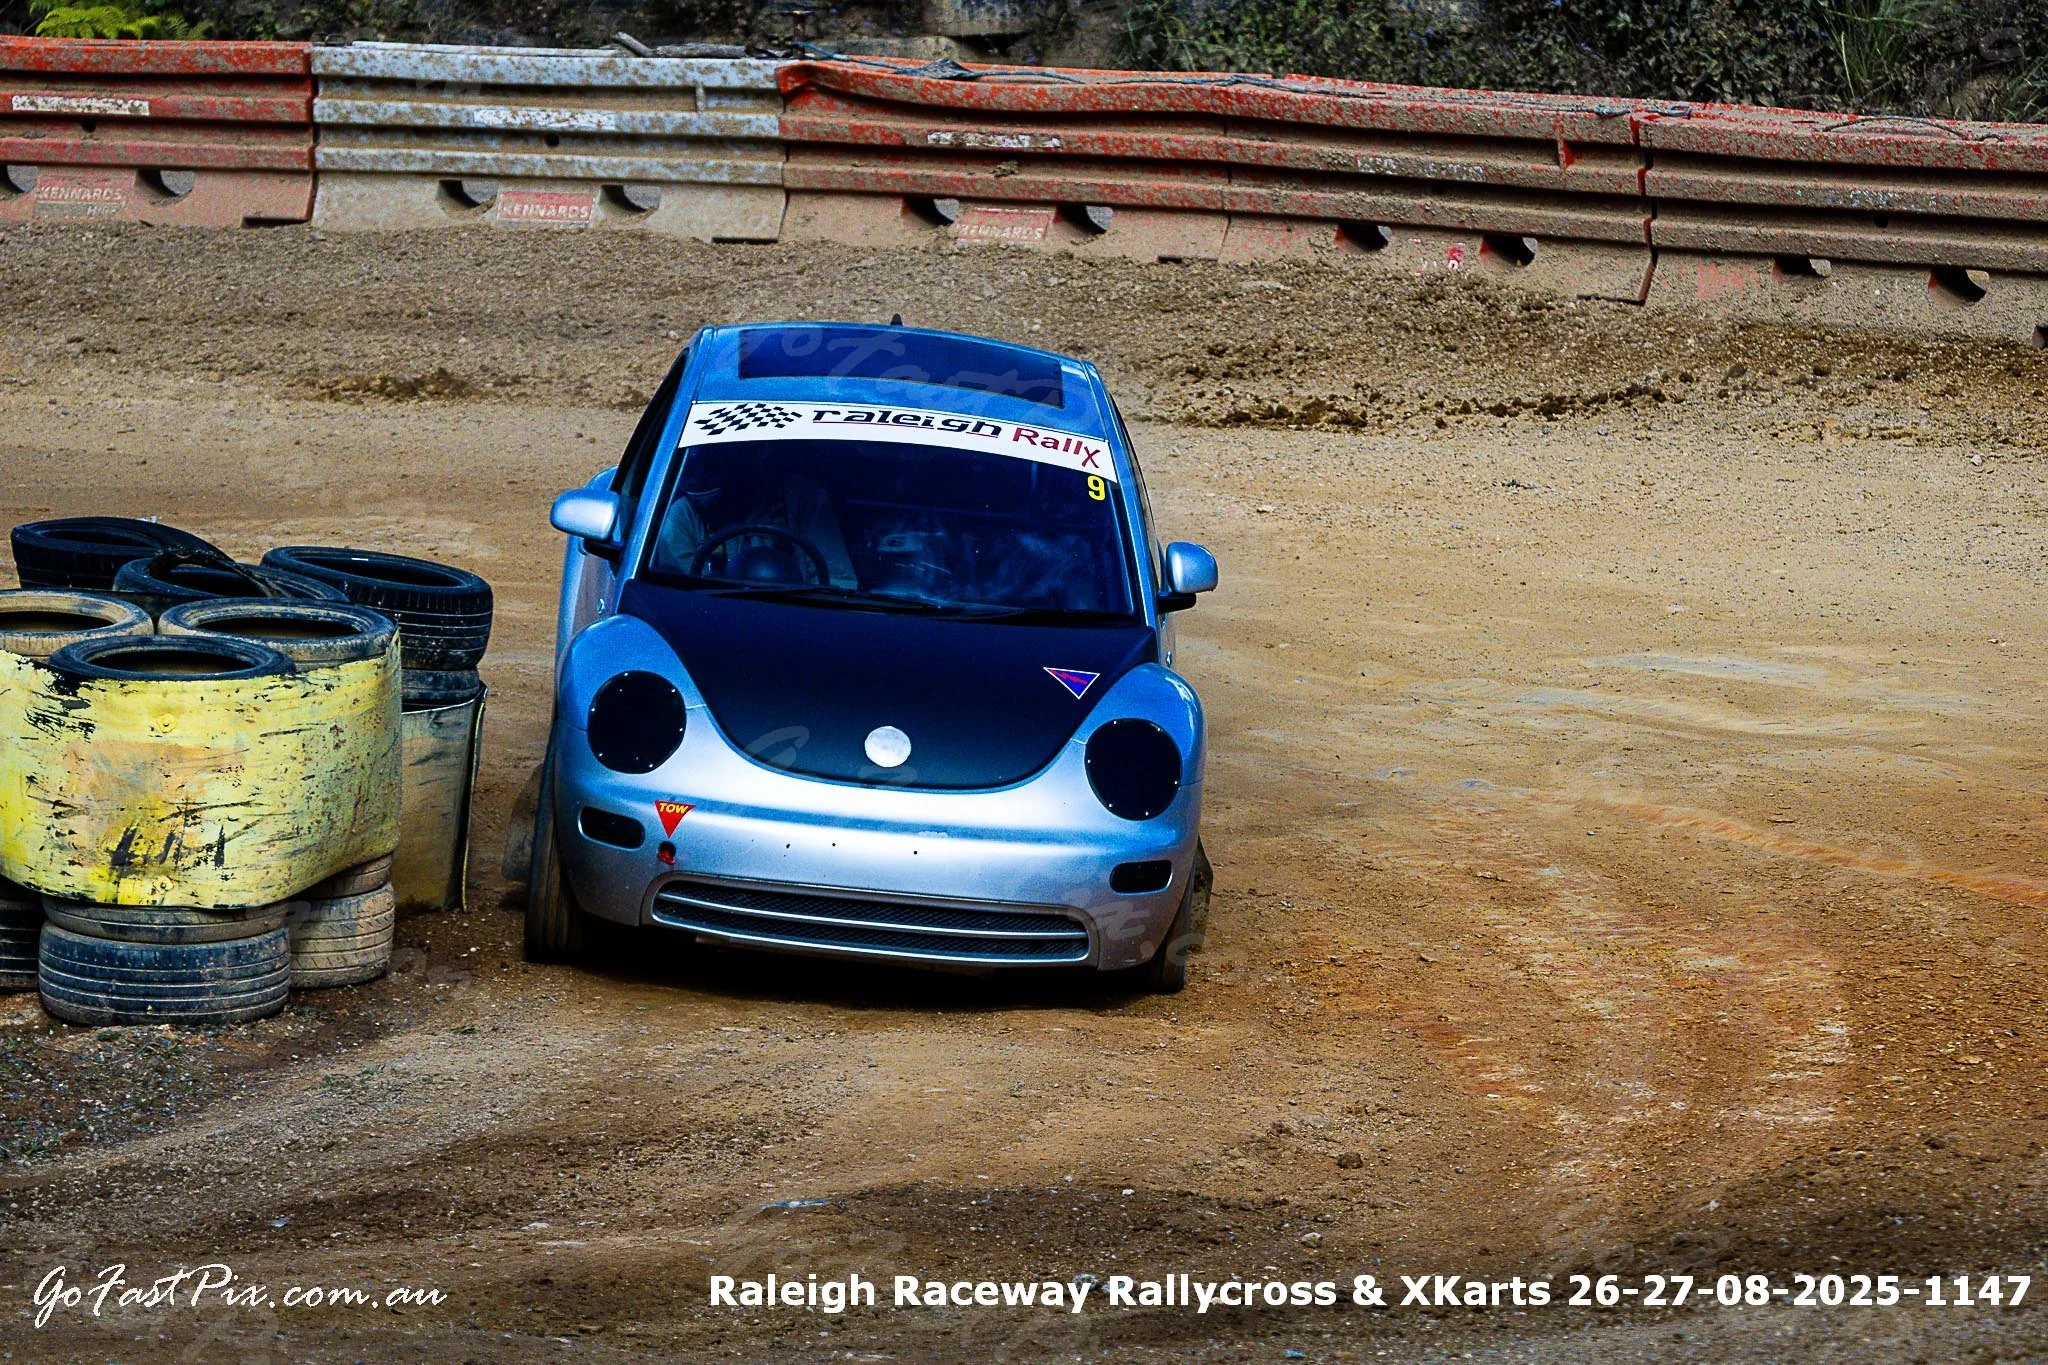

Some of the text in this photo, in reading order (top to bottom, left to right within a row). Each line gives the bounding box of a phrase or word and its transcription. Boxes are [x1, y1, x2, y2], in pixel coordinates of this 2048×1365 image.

[502, 203, 591, 219] KENNARDS
[813, 410, 1002, 437] raleigh
[1087, 475, 1106, 501] 9
[659, 803, 689, 814] TOW
